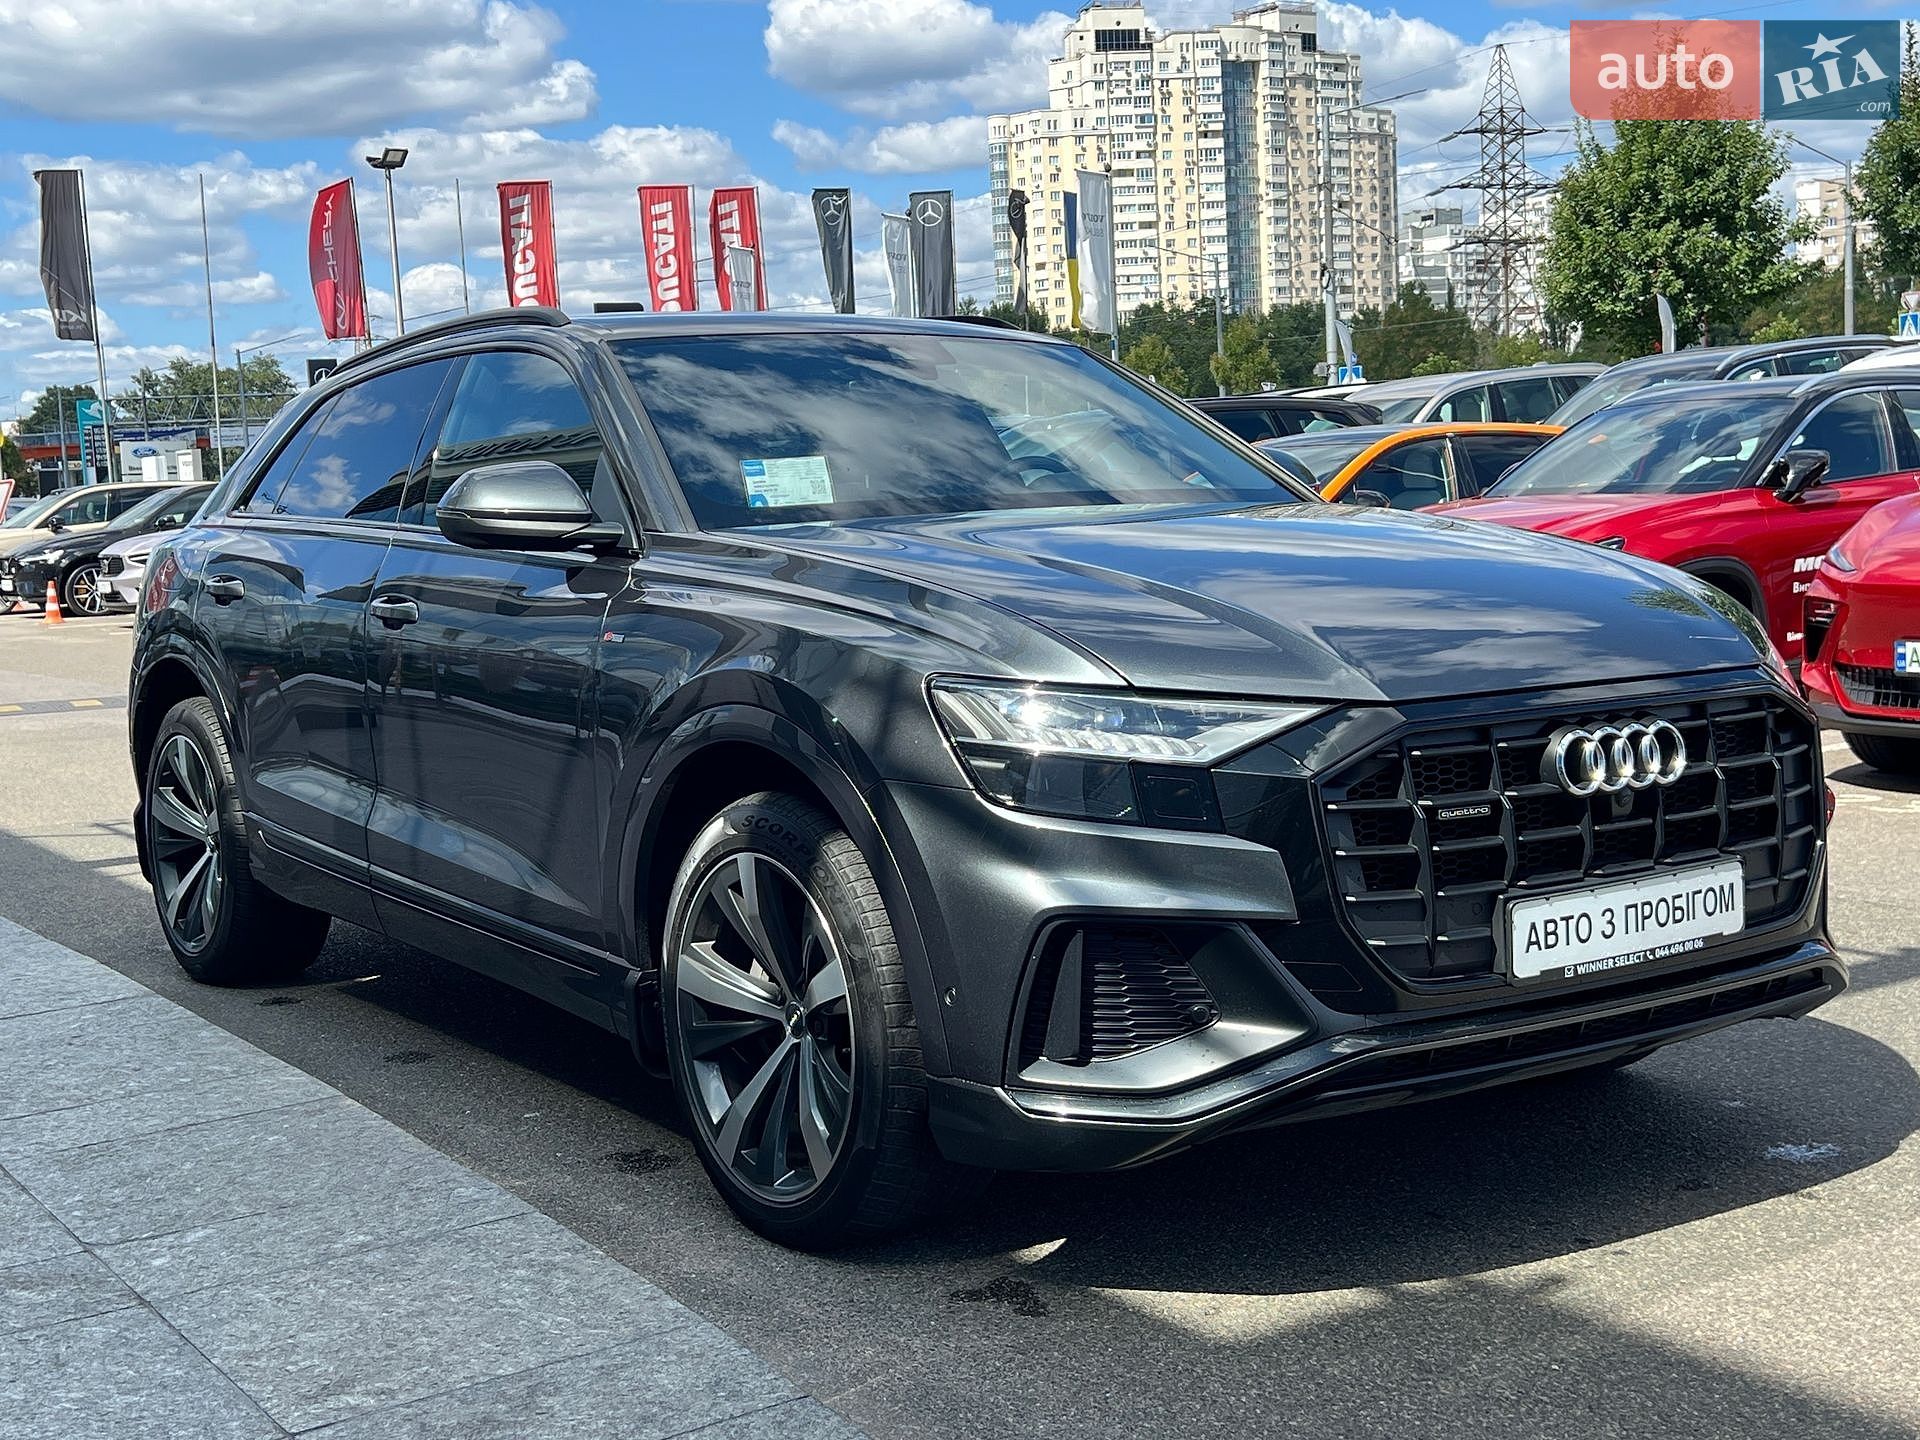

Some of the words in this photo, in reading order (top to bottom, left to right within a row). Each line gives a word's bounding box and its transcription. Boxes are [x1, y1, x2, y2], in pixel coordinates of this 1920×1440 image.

[1441, 806, 1489, 819] quattro
[1524, 912, 1592, 955] АВТО
[1624, 882, 1736, 936] ПРОБІГОМ
[1576, 958, 1614, 975] WINNER
[1615, 952, 1645, 967] SELECT
